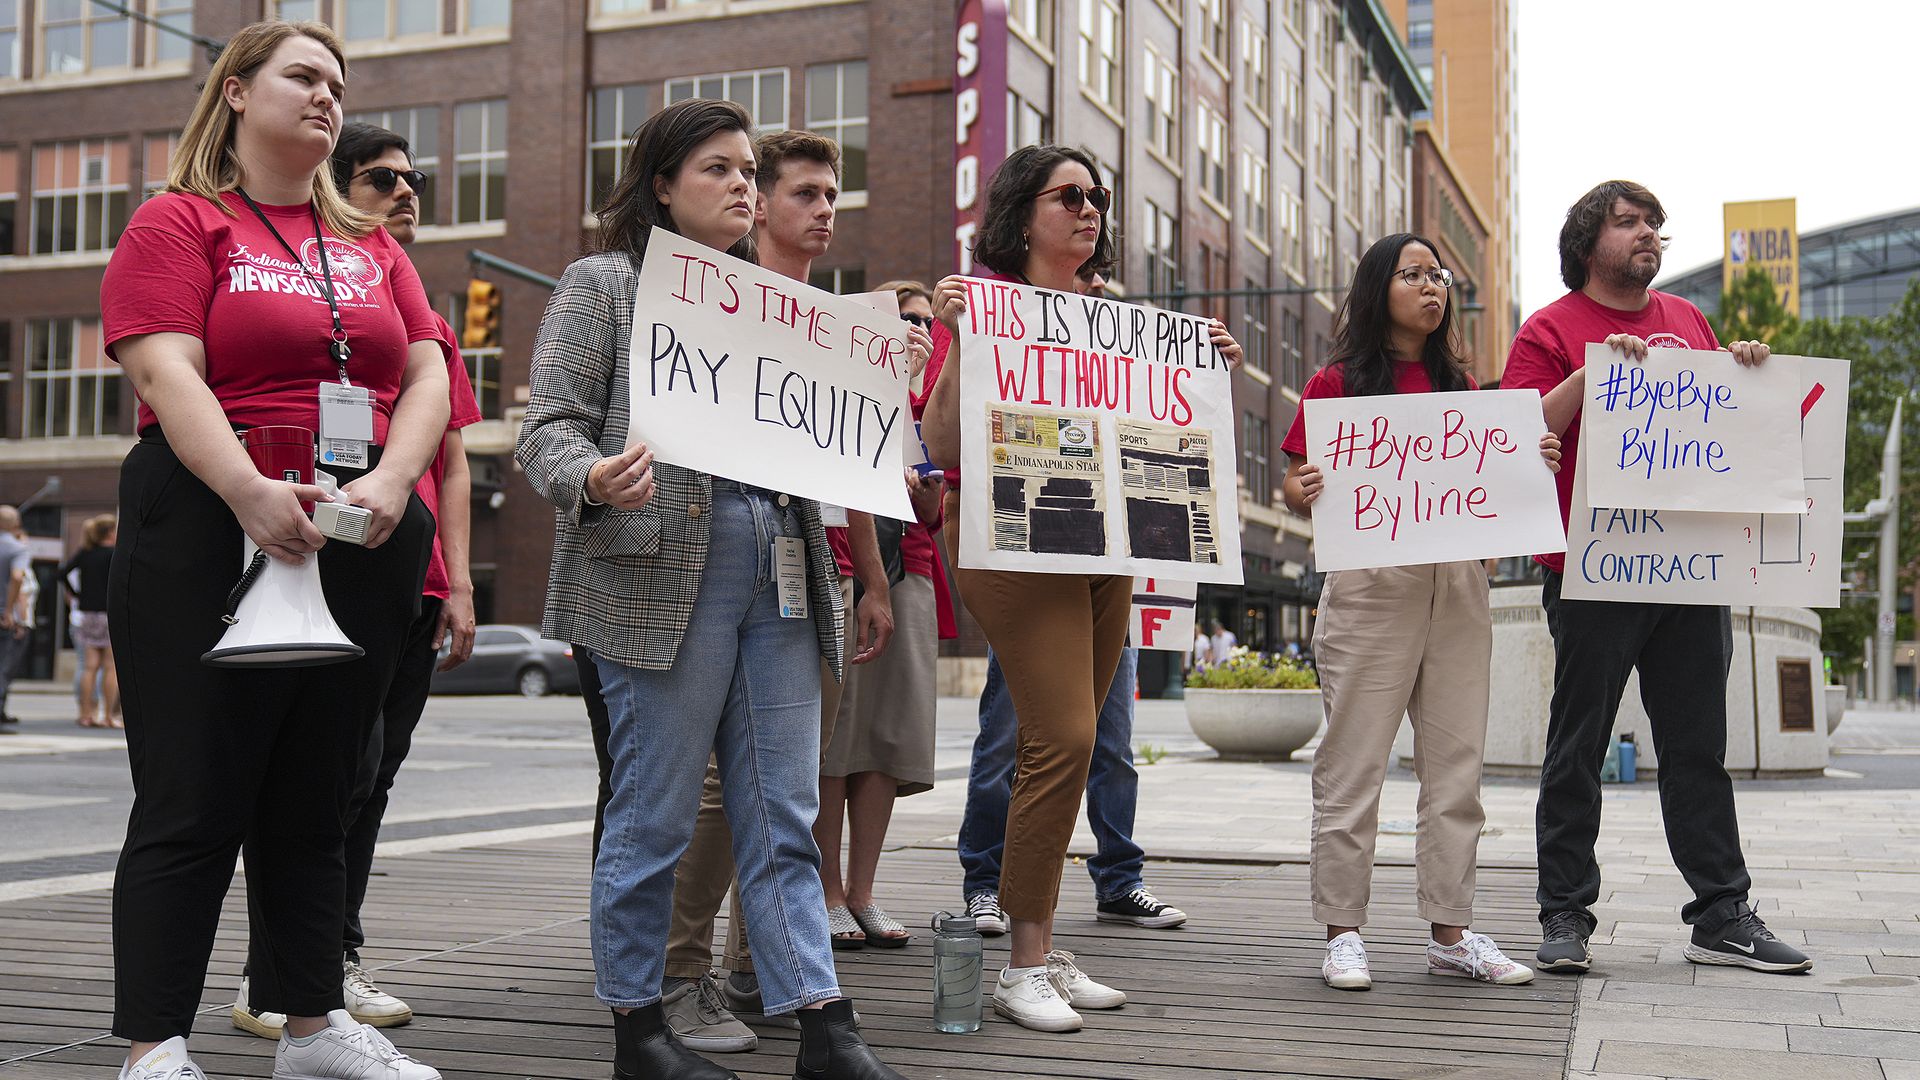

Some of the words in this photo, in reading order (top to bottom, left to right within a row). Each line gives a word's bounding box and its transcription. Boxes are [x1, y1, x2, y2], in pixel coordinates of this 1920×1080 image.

[1749, 228, 1791, 261] NBA
[671, 252, 740, 314] IT'S
[754, 282, 837, 350] TIME
[963, 280, 1026, 341] THIS
[1034, 290, 1071, 345] IS
[1081, 297, 1147, 360] YOUR
[650, 323, 729, 405] PAY
[754, 355, 899, 469] EQUITY
[993, 344, 1134, 413] WITHOUT
[1148, 364, 1193, 427] US
[1119, 433, 1148, 446] SPORTS
[1189, 437, 1208, 446] PACERS
[1617, 427, 1731, 479] Byline
[335, 457, 360, 465] NETWORK
[1014, 454, 1074, 472] INDIANAPOLIS
[1076, 459, 1100, 472] STAR
[1354, 479, 1498, 541] Byline
[1581, 539, 1724, 584] CONTRACT
[1140, 608, 1171, 647] F
[145, 1051, 172, 1069] adidas
